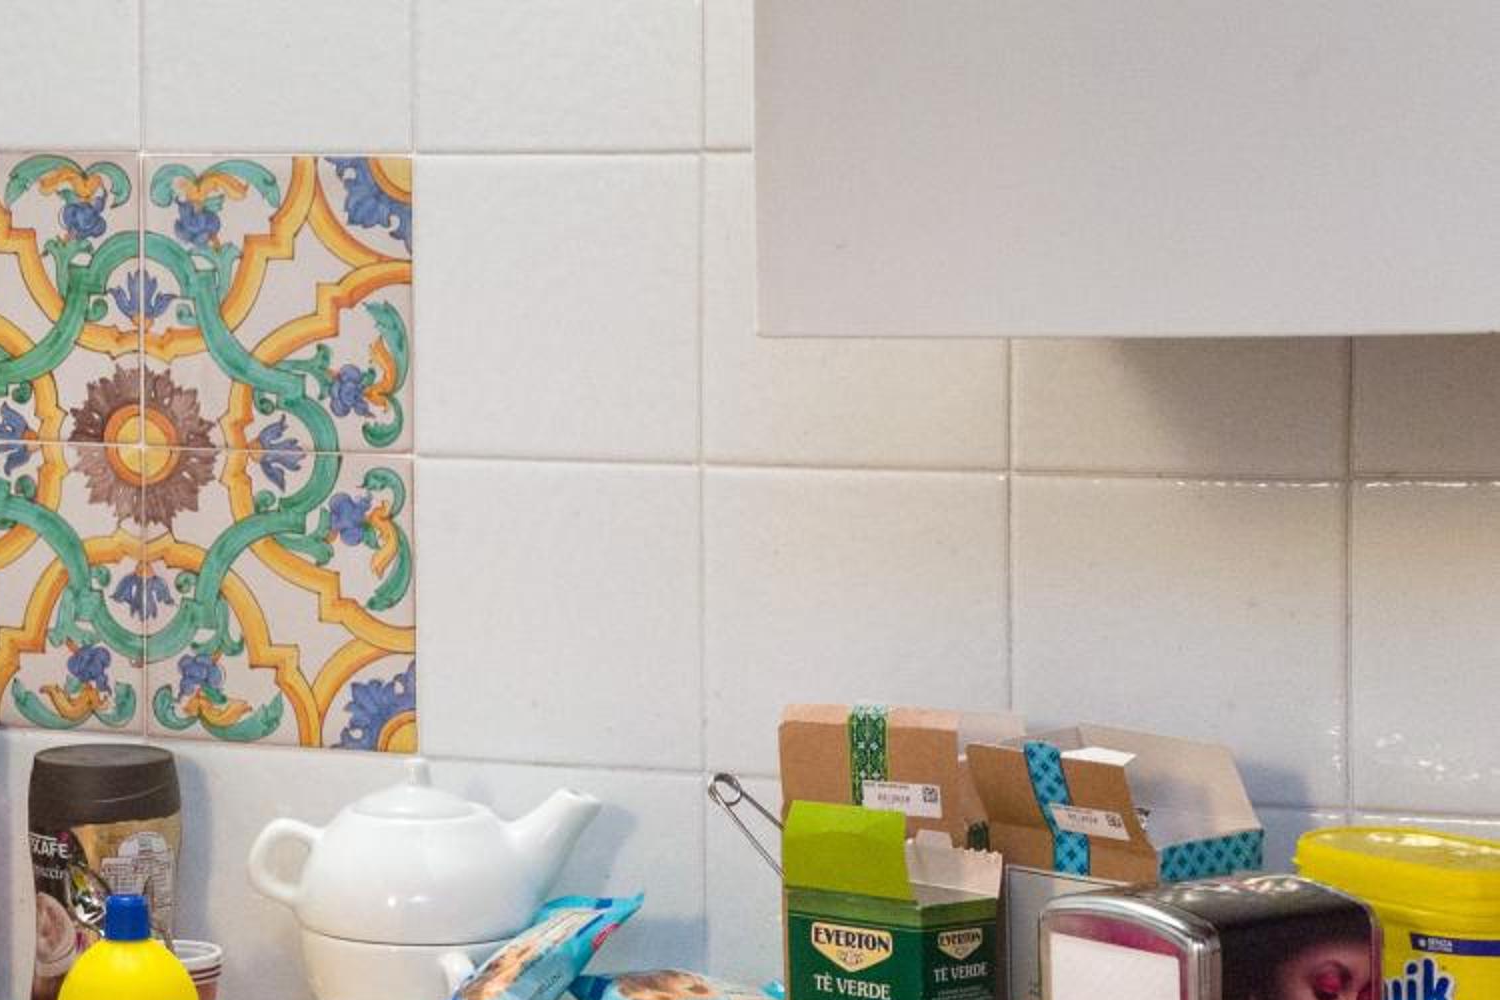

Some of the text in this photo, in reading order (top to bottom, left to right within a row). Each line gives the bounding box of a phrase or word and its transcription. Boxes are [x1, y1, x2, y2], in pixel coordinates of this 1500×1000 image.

[814, 926, 890, 953] EVERTON
[940, 930, 981, 946] EVERTON
[951, 962, 988, 981] VERDE
[836, 977, 891, 1000] VERDE
